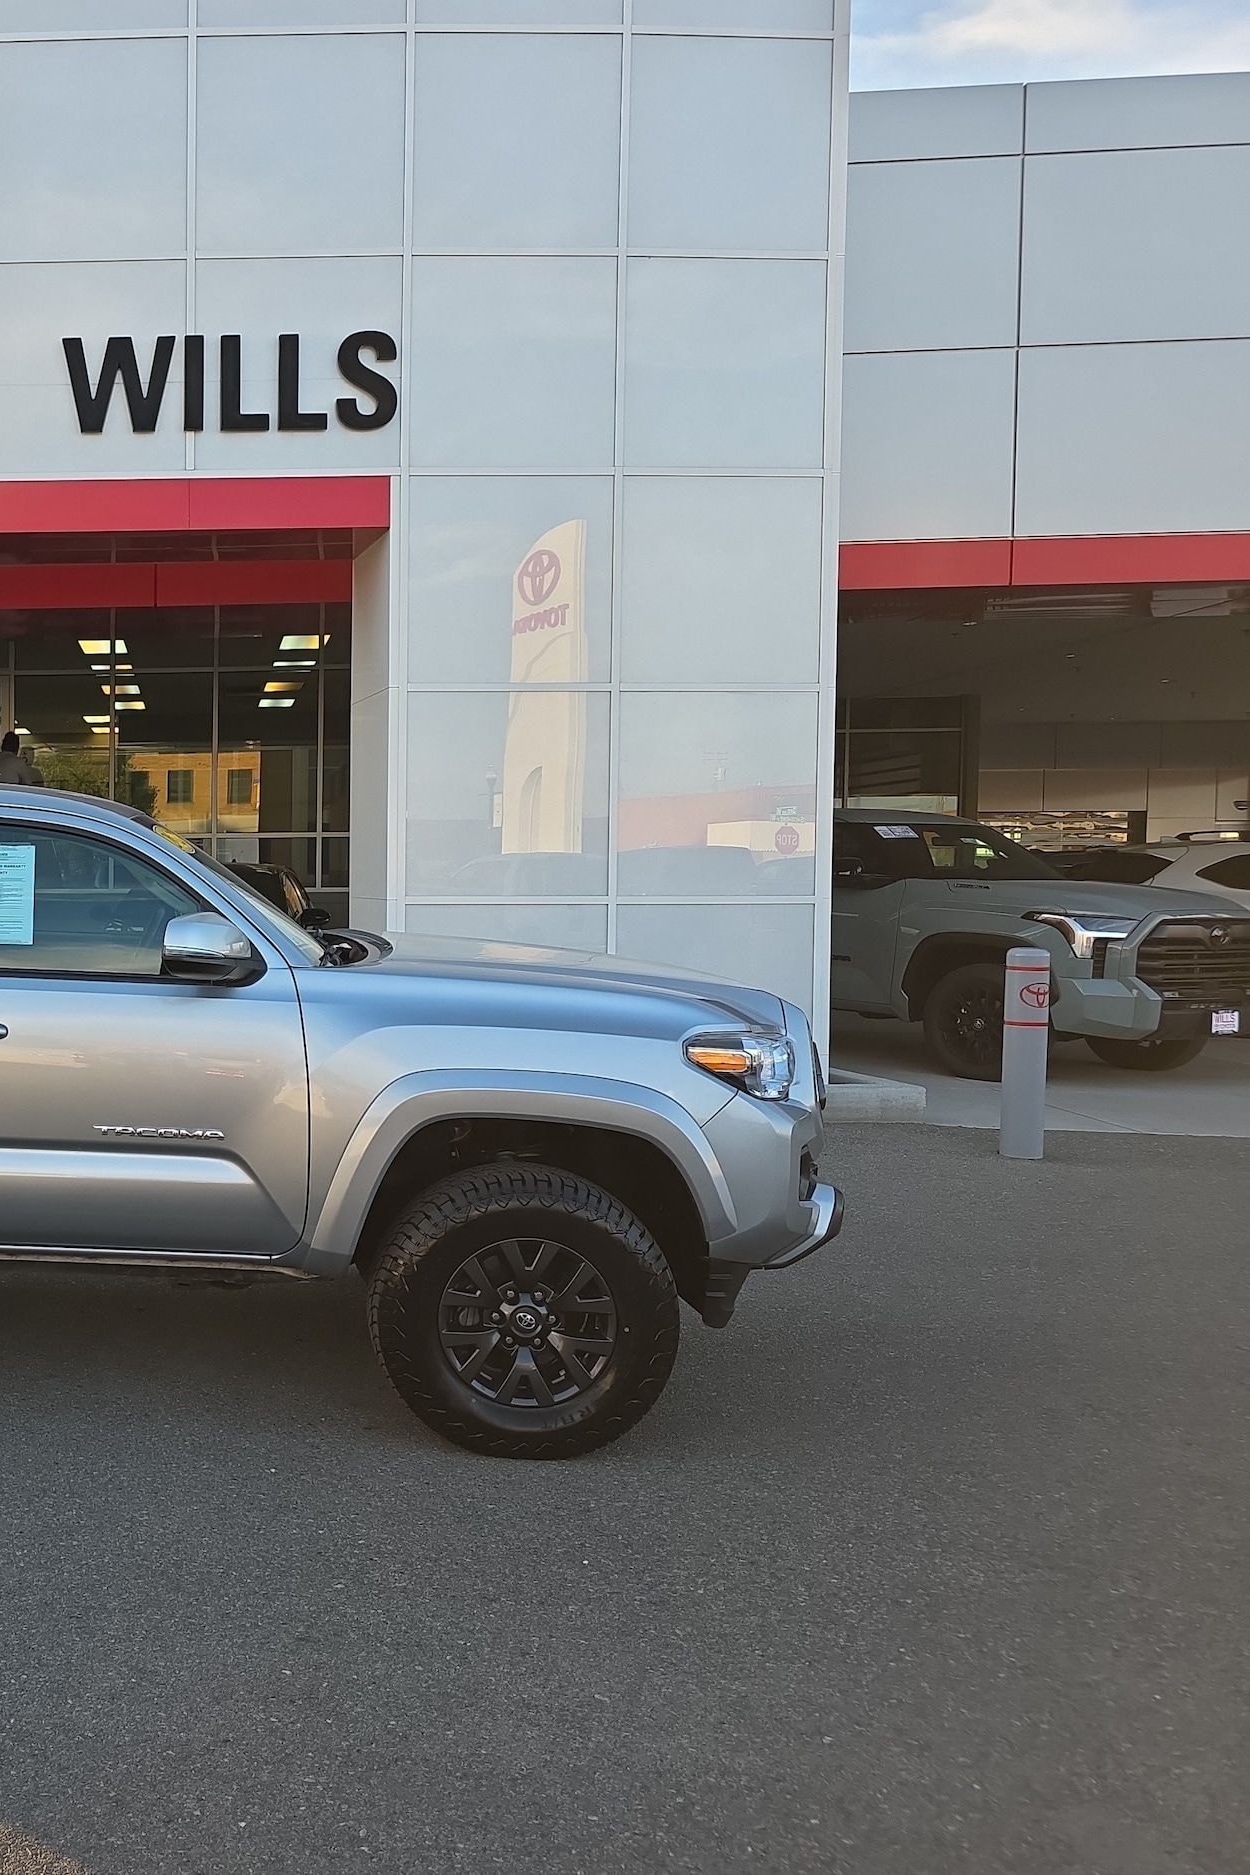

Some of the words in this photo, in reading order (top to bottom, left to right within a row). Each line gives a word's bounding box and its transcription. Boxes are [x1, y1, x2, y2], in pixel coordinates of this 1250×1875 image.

[61, 330, 399, 434] WILLS
[1214, 1014, 1235, 1023] WILLS
[92, 1124, 226, 1141] TACOMA
